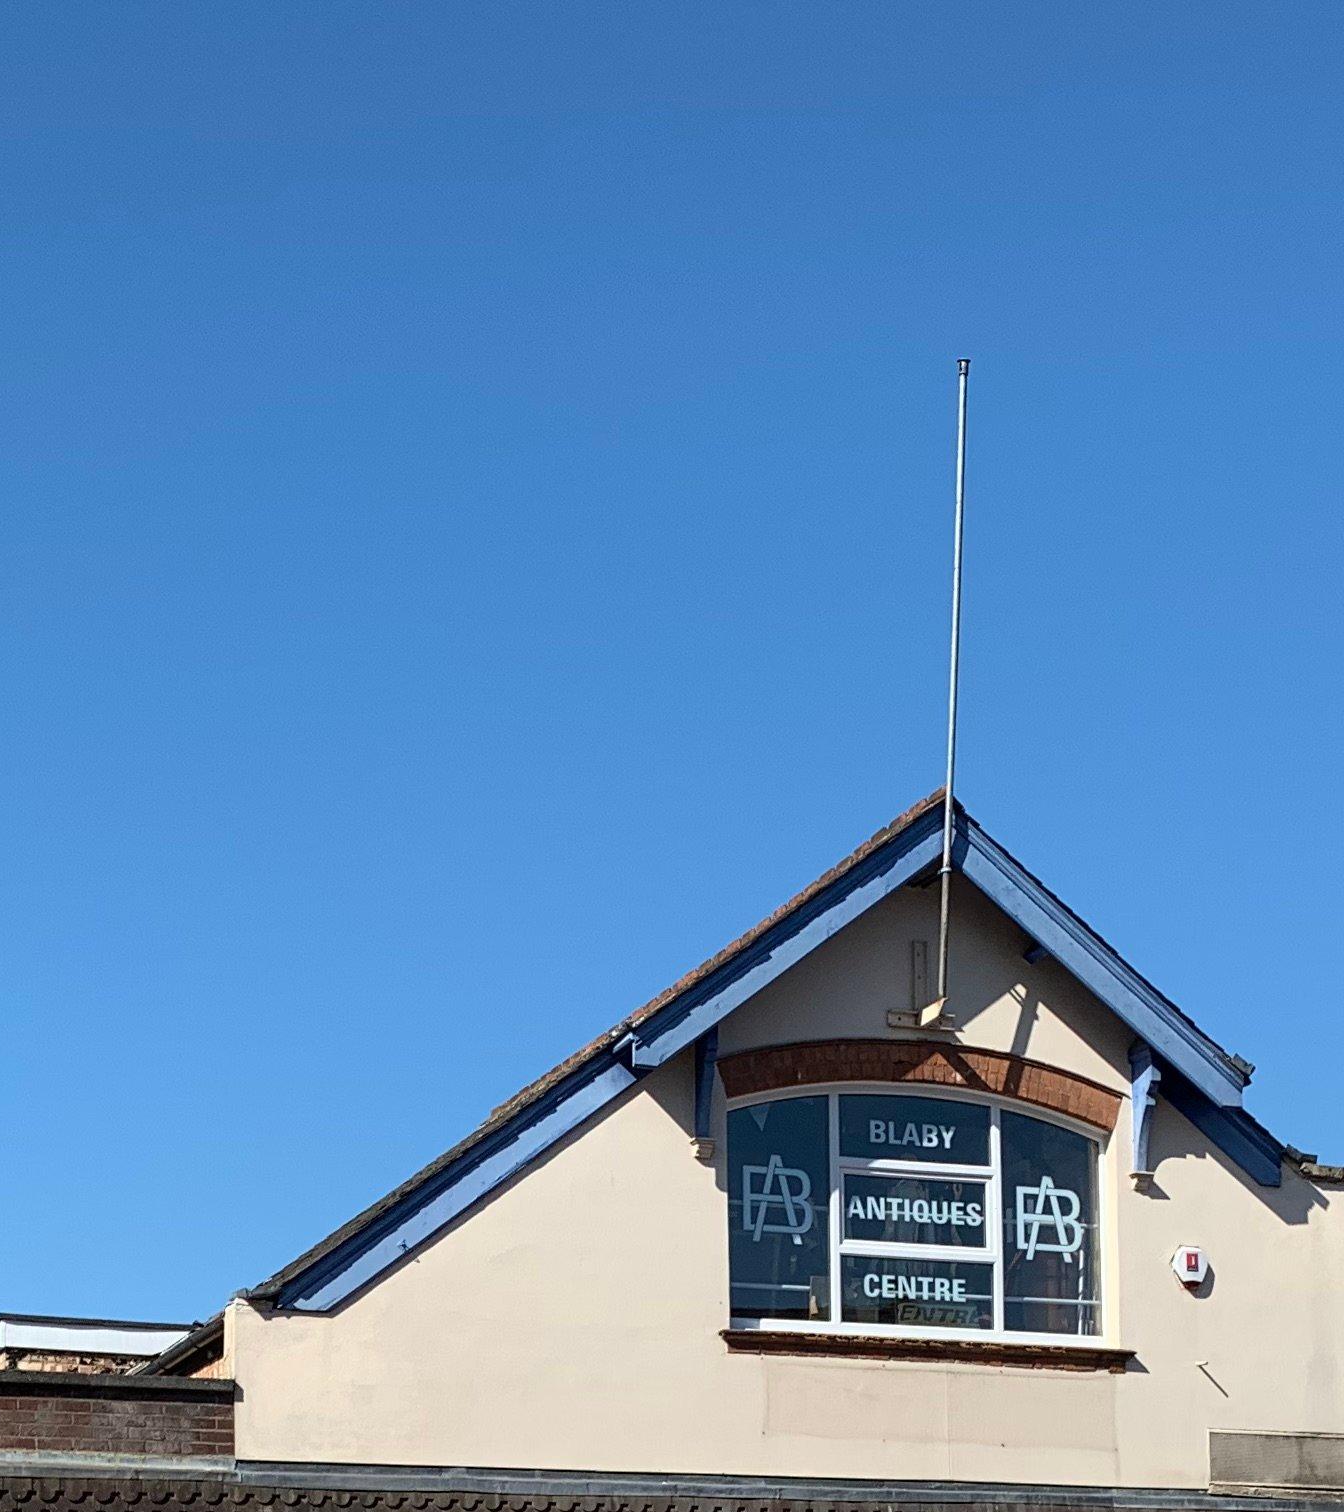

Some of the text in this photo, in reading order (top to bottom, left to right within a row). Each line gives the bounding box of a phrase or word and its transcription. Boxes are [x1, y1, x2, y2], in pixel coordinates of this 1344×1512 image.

[869, 1119, 956, 1150] BLABY
[847, 1195, 984, 1228] ANTIQUES
[863, 1273, 967, 1303] CENTRE
